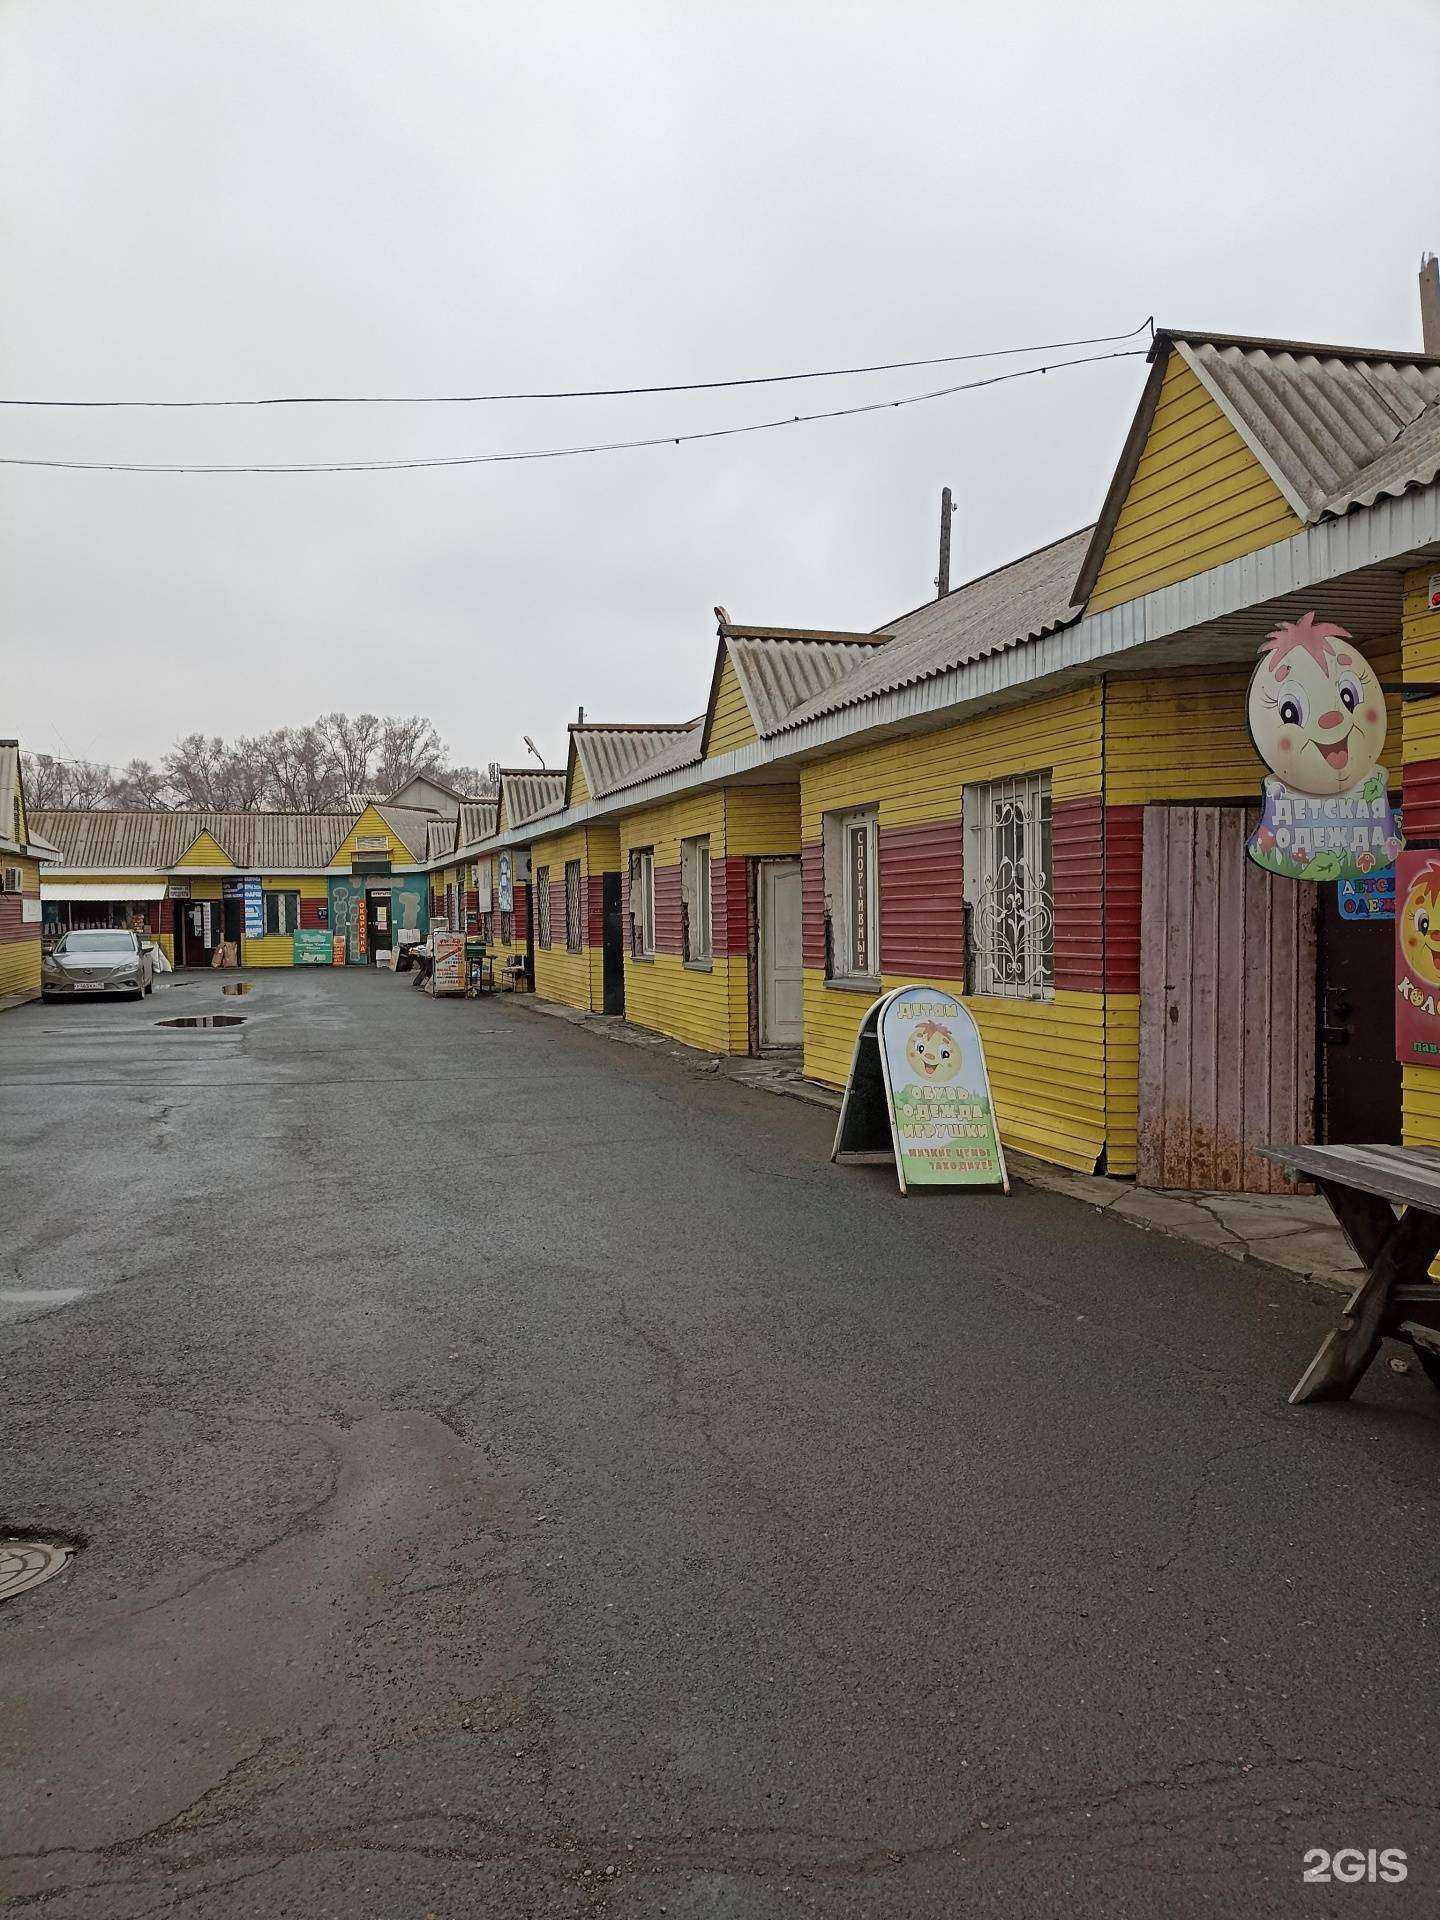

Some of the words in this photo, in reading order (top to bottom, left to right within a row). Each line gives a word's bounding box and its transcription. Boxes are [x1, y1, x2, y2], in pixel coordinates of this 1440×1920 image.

[1272, 799, 1386, 825] ДЕТСКАЯ
[1275, 827, 1385, 852] ОДЕЖДА
[857, 832, 865, 966] СПОРТИВНЫЕ
[1398, 976, 1440, 1016] КОЛ
[897, 1002, 959, 1019] ДЕТЯМ
[911, 1085, 969, 1101] ОБУВЬ
[903, 1103, 983, 1121] ОДЕЖДА
[902, 1123, 989, 1139] ИГРУШКИ
